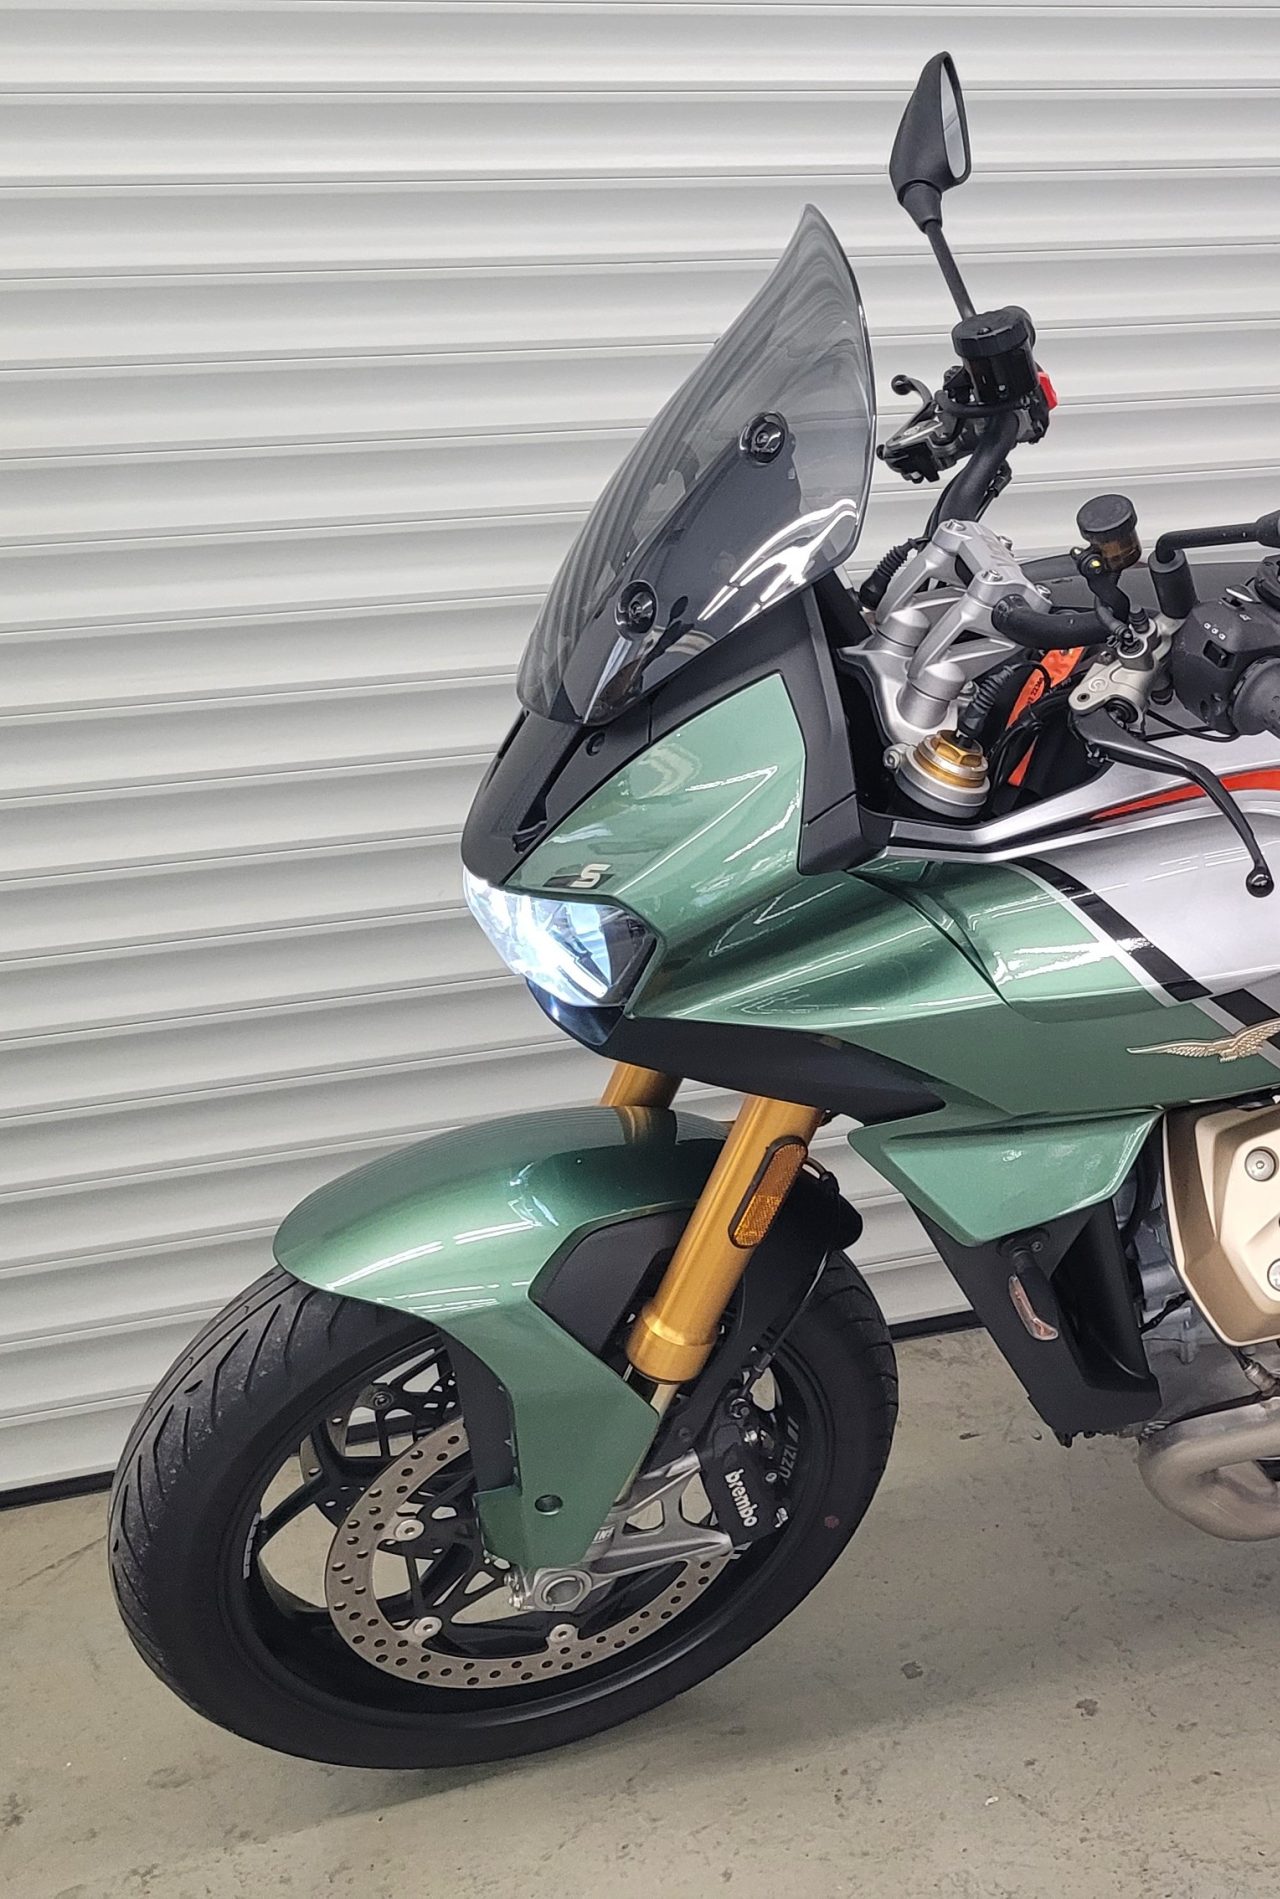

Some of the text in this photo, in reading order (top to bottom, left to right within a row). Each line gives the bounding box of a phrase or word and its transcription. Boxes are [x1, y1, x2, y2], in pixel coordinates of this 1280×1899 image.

[569, 863, 612, 888] S
[778, 1444, 799, 1485] UZZI
[724, 1468, 758, 1527] brembo
